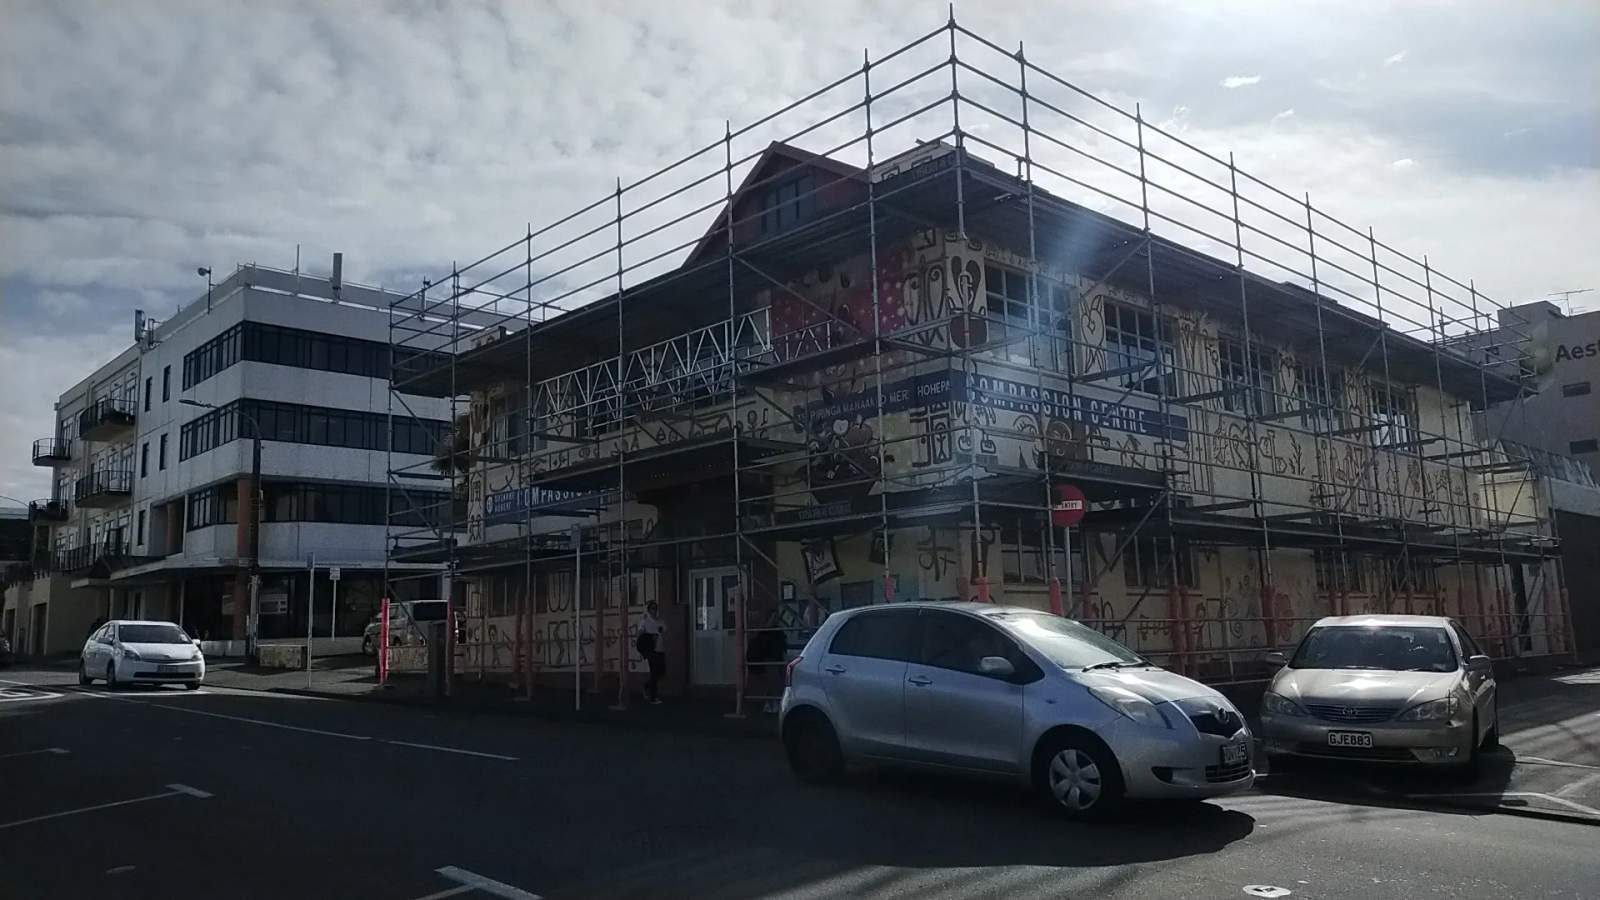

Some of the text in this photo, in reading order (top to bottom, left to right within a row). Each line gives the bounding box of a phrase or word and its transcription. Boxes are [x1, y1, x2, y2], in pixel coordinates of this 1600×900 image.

[1556, 340, 1600, 363] Aes
[917, 380, 952, 397] HOHEPA
[966, 375, 1147, 433] COMPASSION CENTRE
[1329, 734, 1371, 746] GJE883
